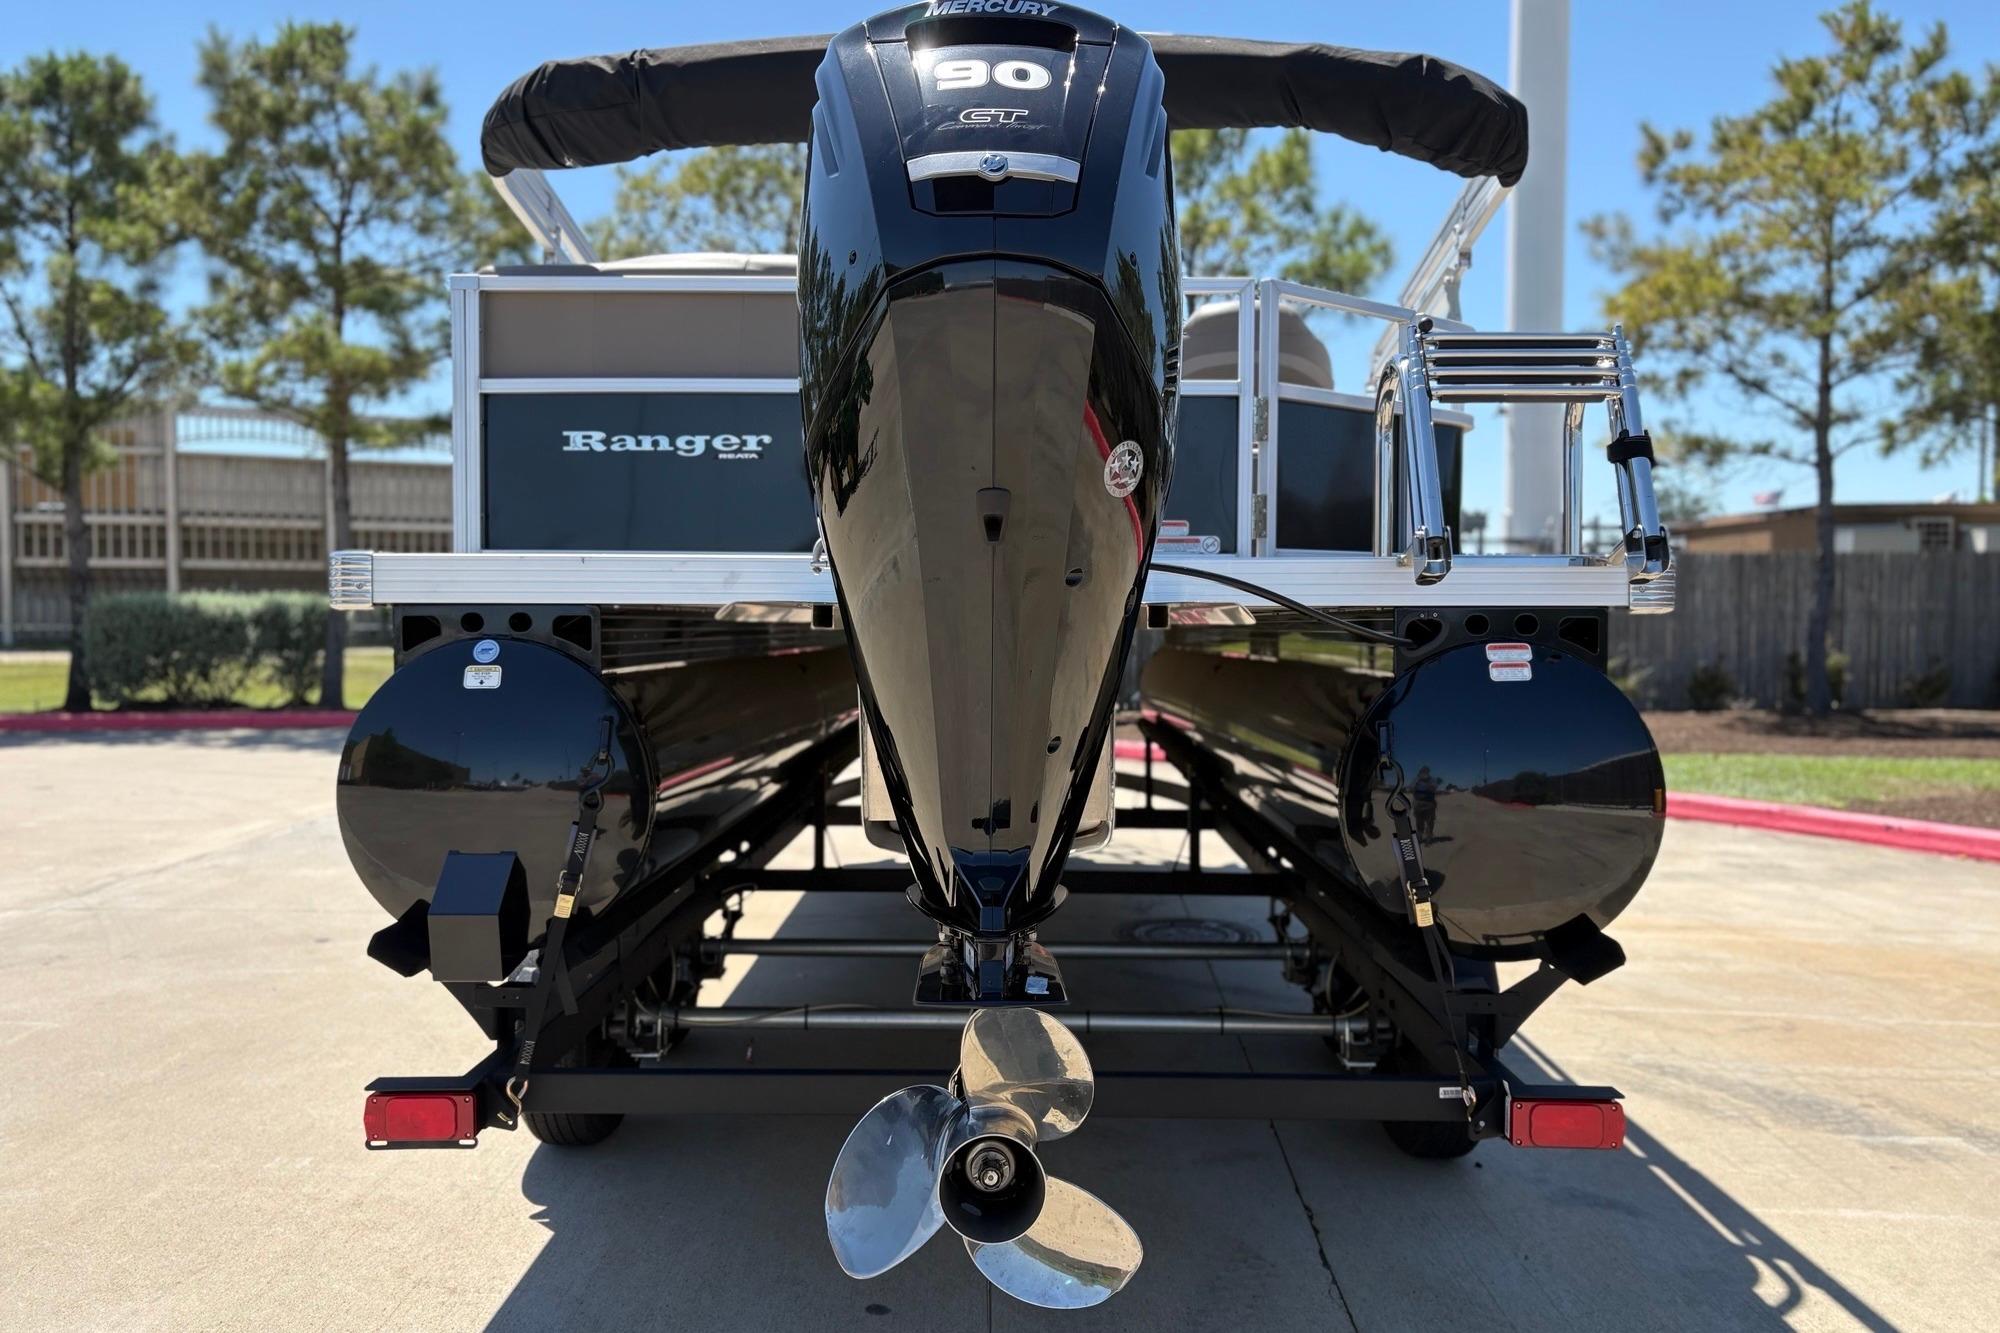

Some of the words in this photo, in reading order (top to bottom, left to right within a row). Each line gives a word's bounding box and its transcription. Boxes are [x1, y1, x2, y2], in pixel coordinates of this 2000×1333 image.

[924, 0, 1059, 17] MERCURY
[934, 60, 1052, 91] 90
[960, 108, 1028, 122] GT
[562, 431, 772, 457] Ranger
